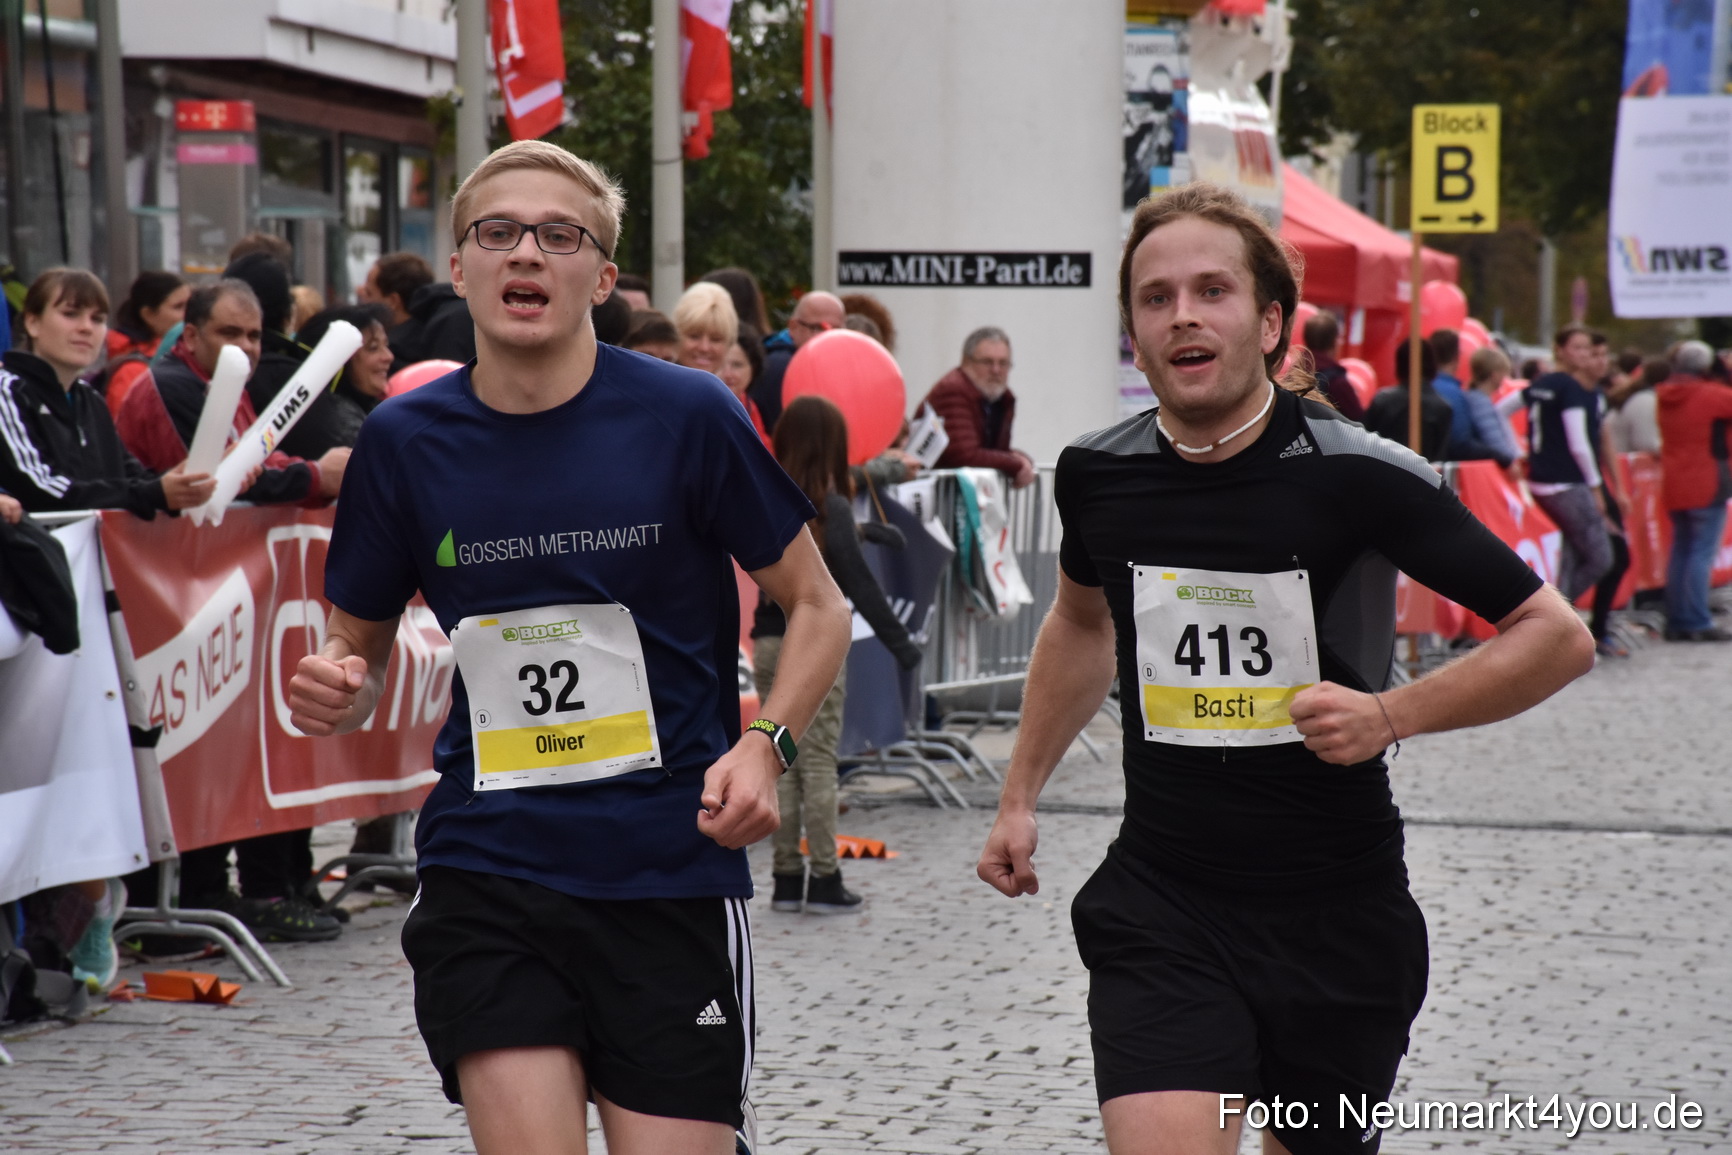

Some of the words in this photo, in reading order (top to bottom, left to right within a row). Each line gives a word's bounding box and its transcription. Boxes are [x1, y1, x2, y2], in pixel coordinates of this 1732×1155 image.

[1423, 111, 1488, 134] Block
[1436, 144, 1475, 203] B
[459, 537, 534, 565] GOSSEN
[539, 523, 663, 555] METRAWATT
[1195, 586, 1255, 603] BOCK
[518, 619, 581, 640] BOCK
[1174, 624, 1273, 677] 413
[148, 658, 187, 736] AS
[196, 602, 244, 713] NEUE
[518, 659, 585, 716] 32
[1194, 693, 1255, 719] Basti
[536, 733, 586, 754] Oliver
[696, 1015, 727, 1026] adidas
